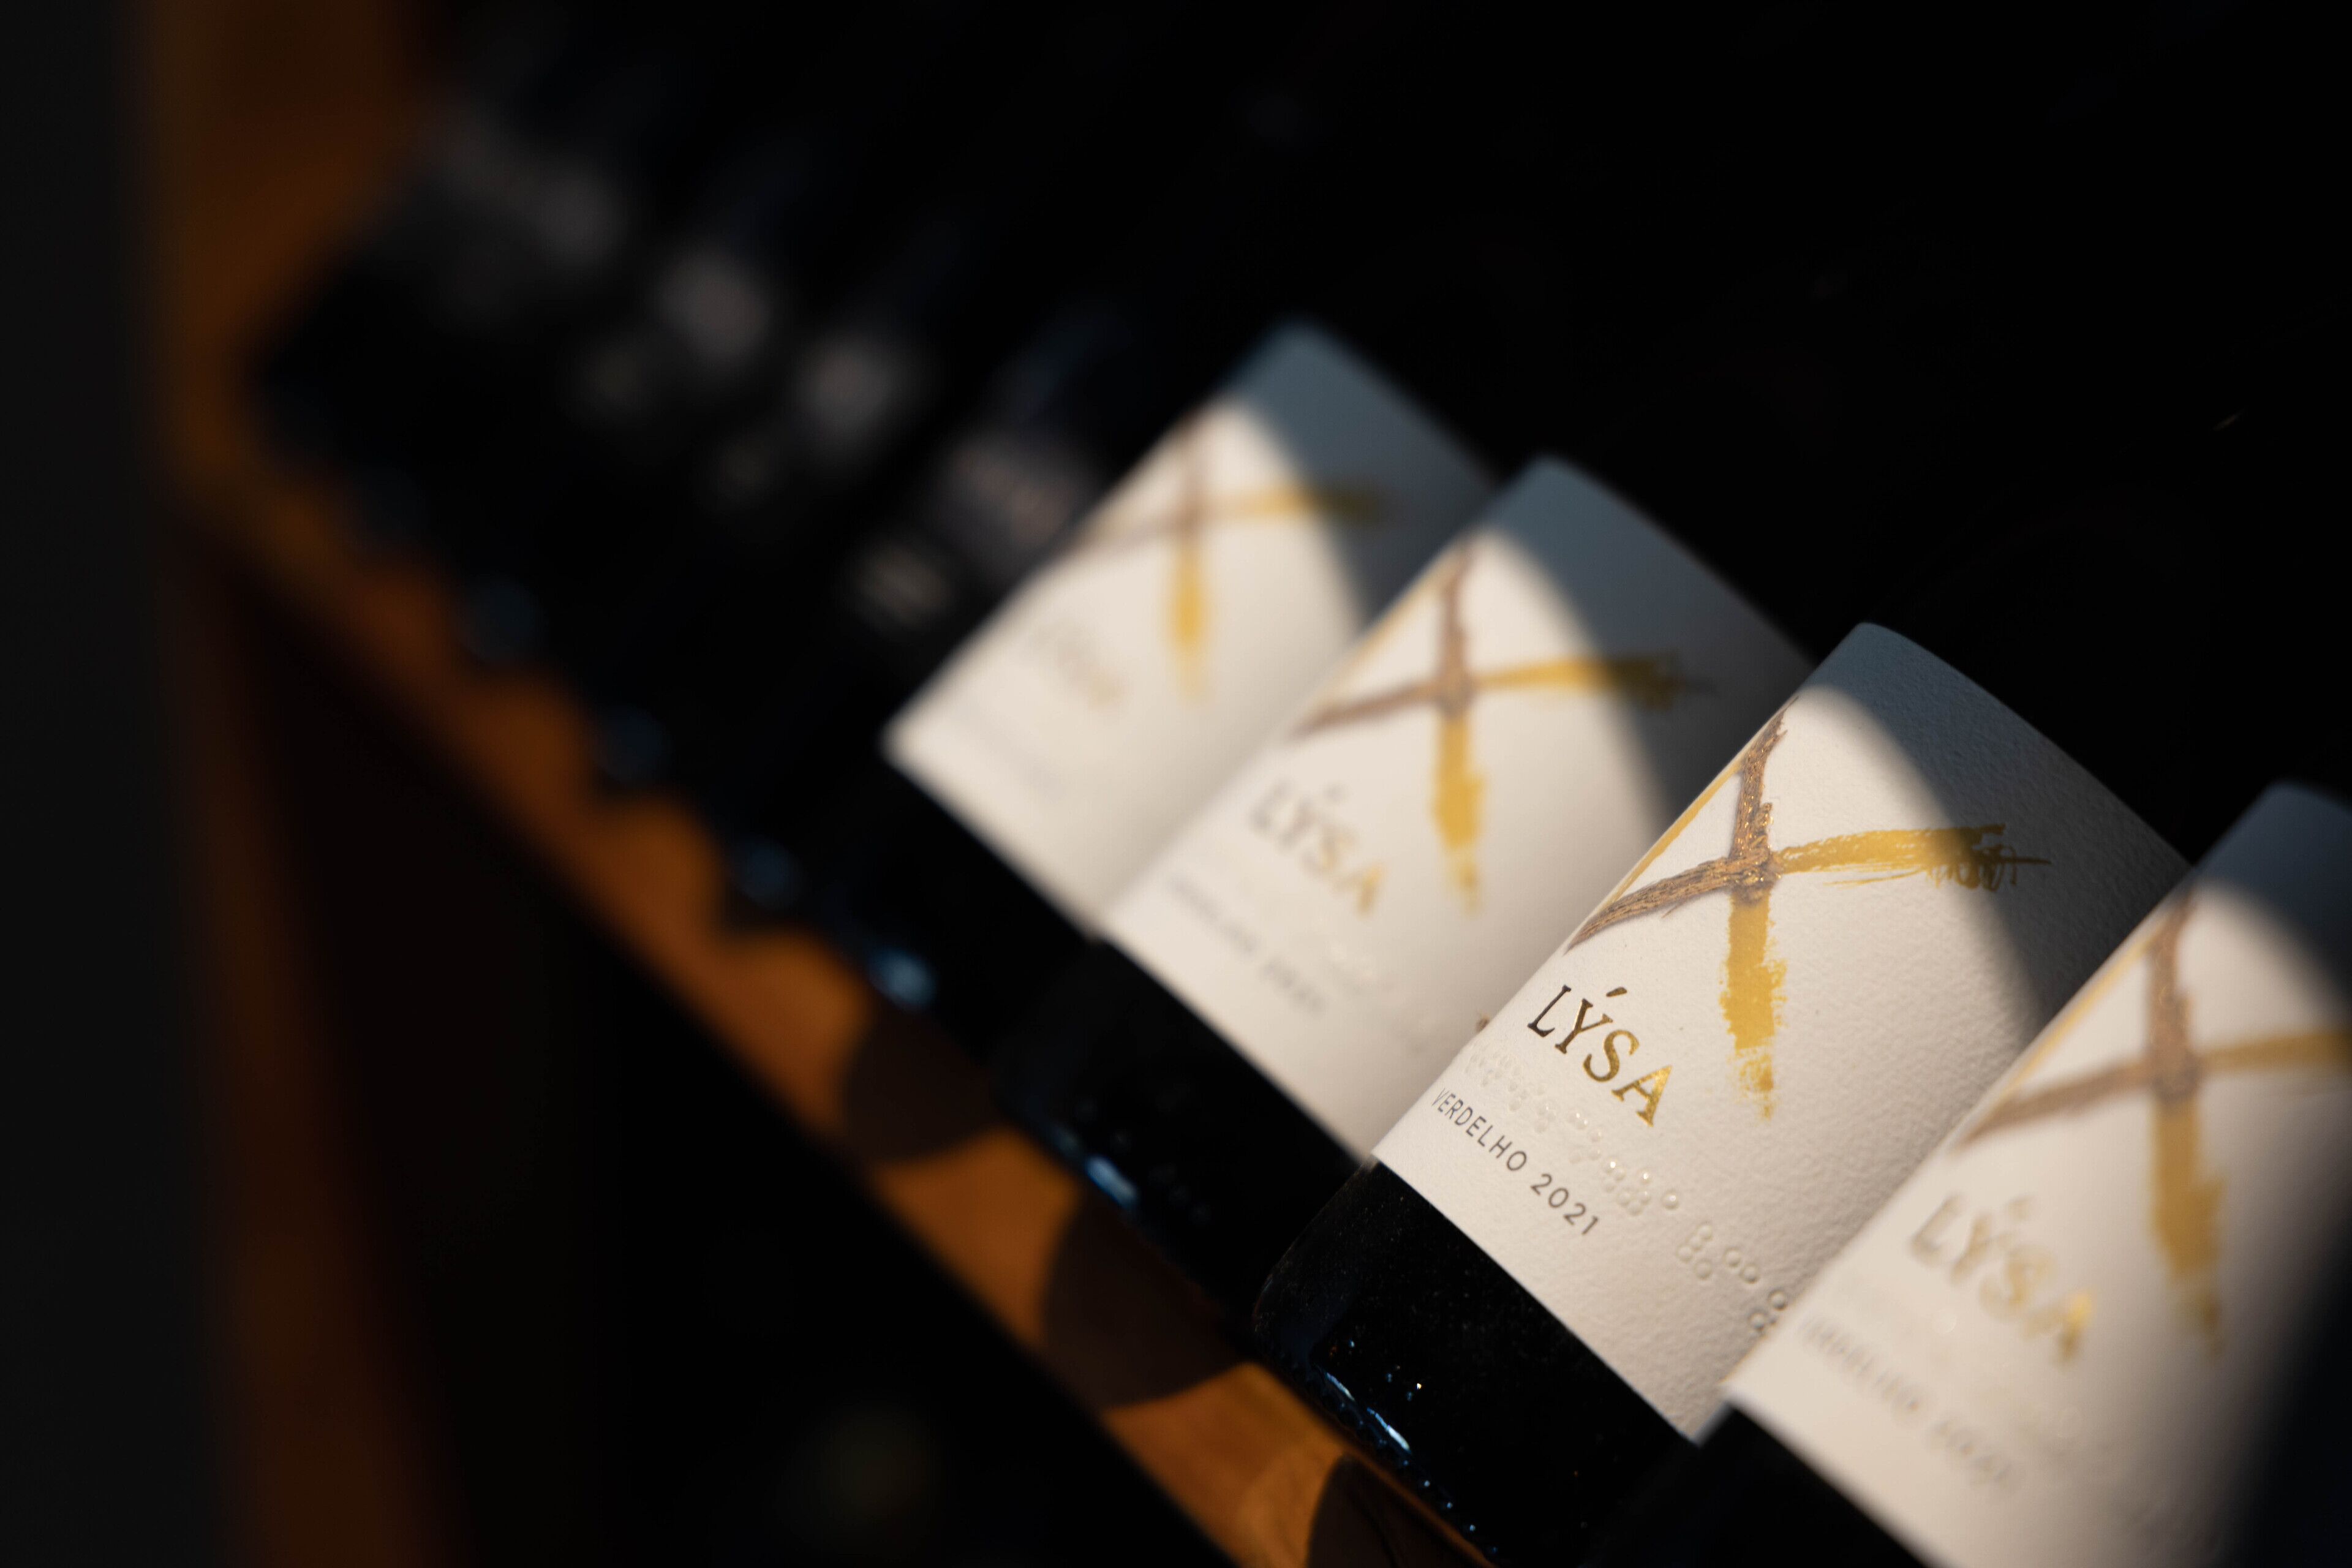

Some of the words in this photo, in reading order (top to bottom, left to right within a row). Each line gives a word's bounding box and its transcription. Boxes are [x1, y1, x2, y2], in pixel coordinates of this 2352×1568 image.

[1527, 984, 1673, 1128] LÝSA
[1431, 1087, 1529, 1172] VERDELHO
[1530, 1172, 1600, 1236] 2021
